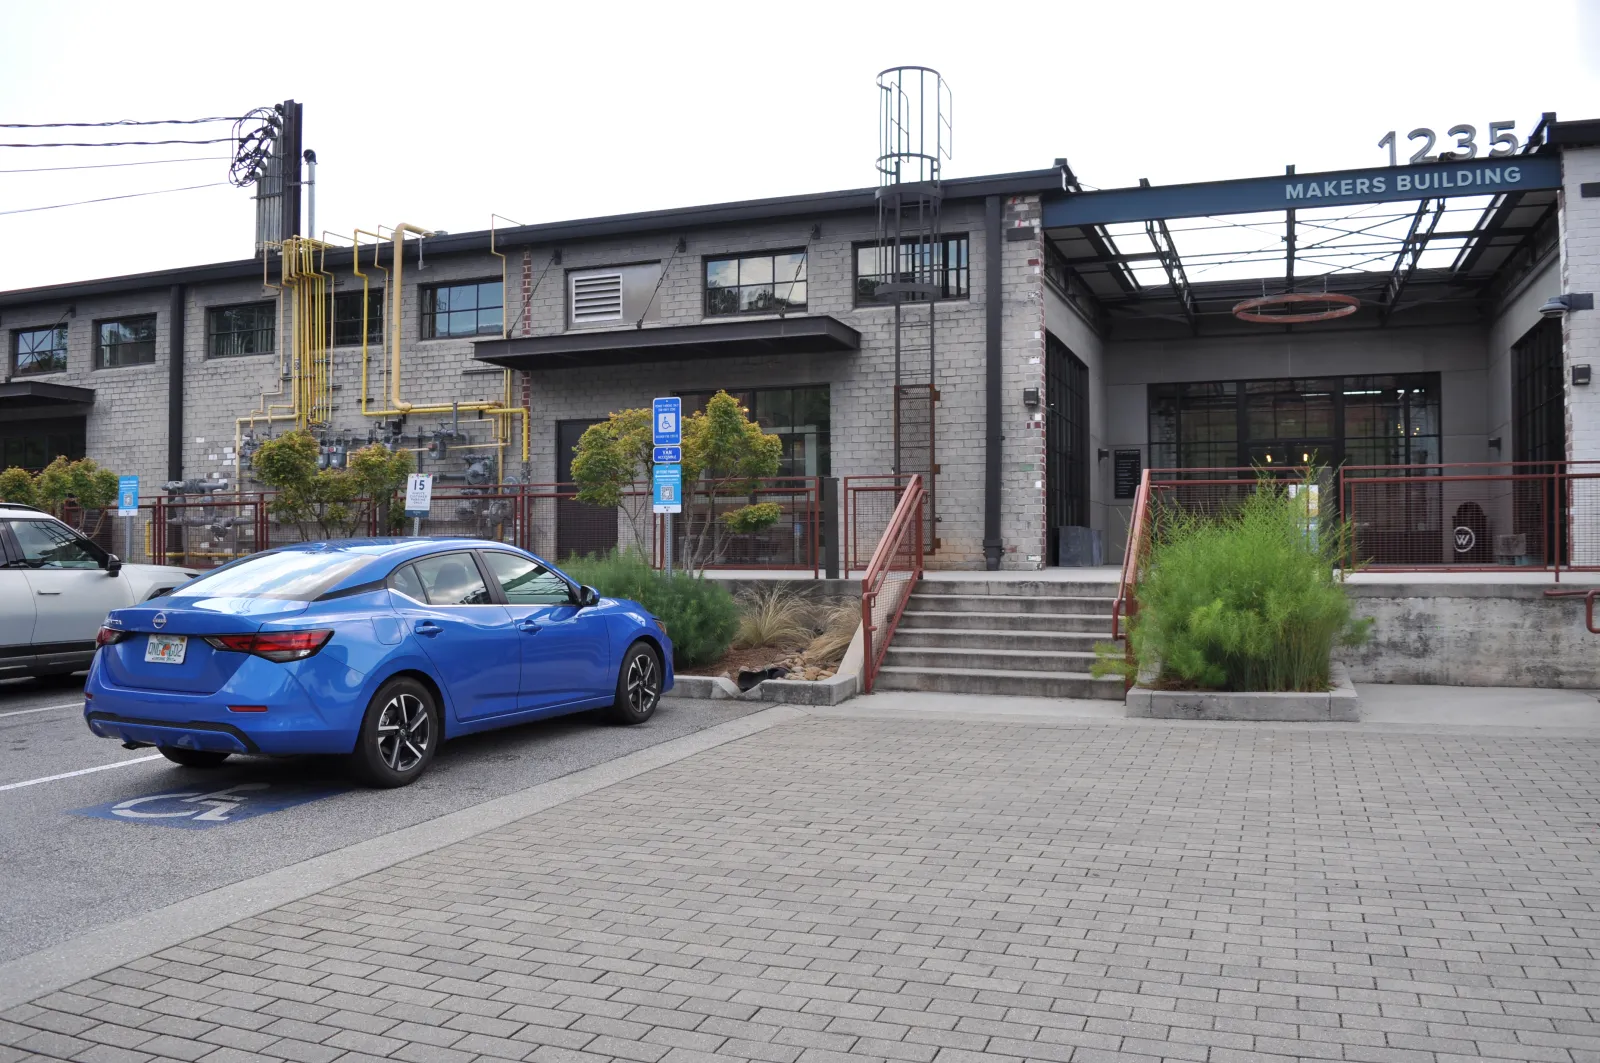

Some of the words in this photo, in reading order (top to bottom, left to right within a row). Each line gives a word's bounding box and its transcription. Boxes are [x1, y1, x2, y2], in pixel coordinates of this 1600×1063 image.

[1378, 120, 1519, 167] 1235
[1286, 177, 1387, 200] MAKERS
[1397, 166, 1521, 191] BUILDING
[414, 480, 425, 490] 15
